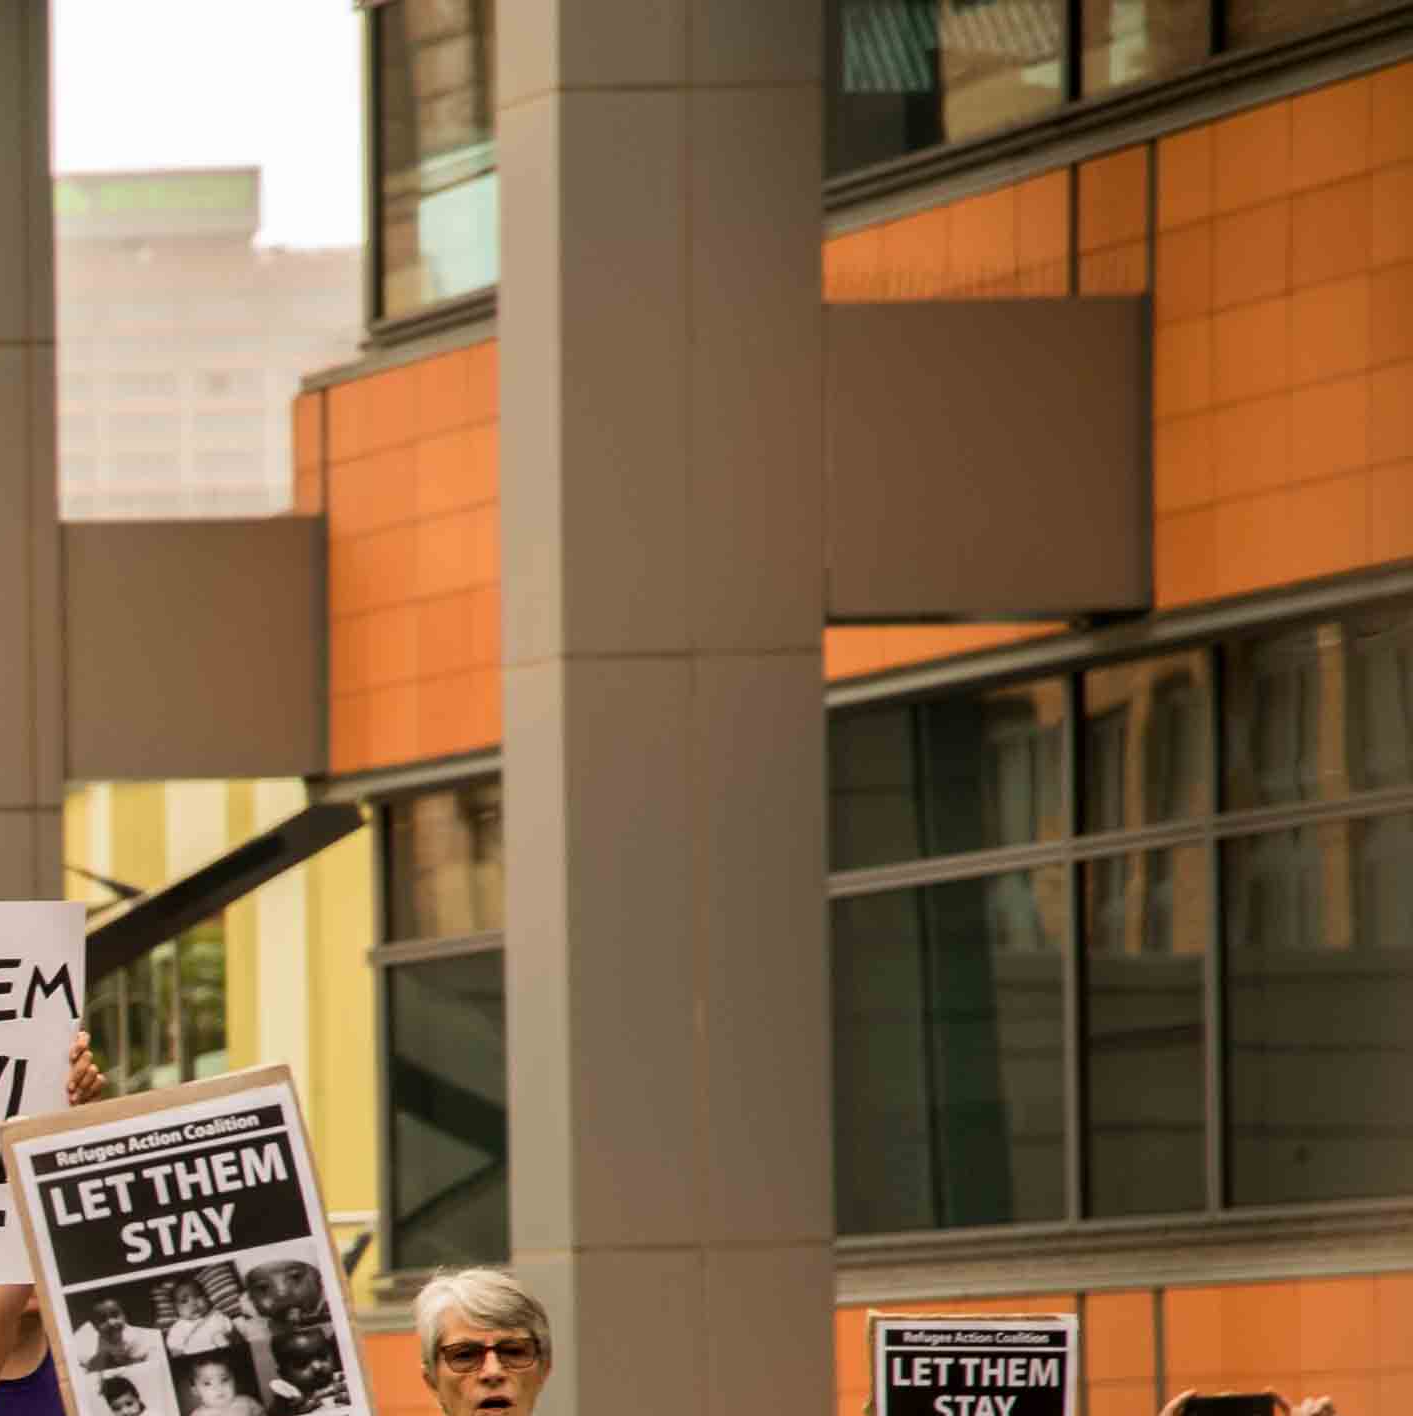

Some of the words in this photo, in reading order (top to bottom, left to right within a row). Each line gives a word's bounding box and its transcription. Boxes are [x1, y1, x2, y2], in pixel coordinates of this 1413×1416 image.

[55, 1142, 127, 1167] Refugee
[128, 1128, 182, 1152] Action
[183, 1114, 260, 1141] Coalition
[49, 1172, 136, 1227] LET
[141, 1141, 289, 1206] THEM
[120, 1203, 236, 1264] STAY
[903, 1331, 952, 1347] Refugee
[954, 1331, 993, 1344] Action
[994, 1331, 1050, 1345] Coalition
[892, 1357, 954, 1387] LET
[959, 1357, 1060, 1388] THEM
